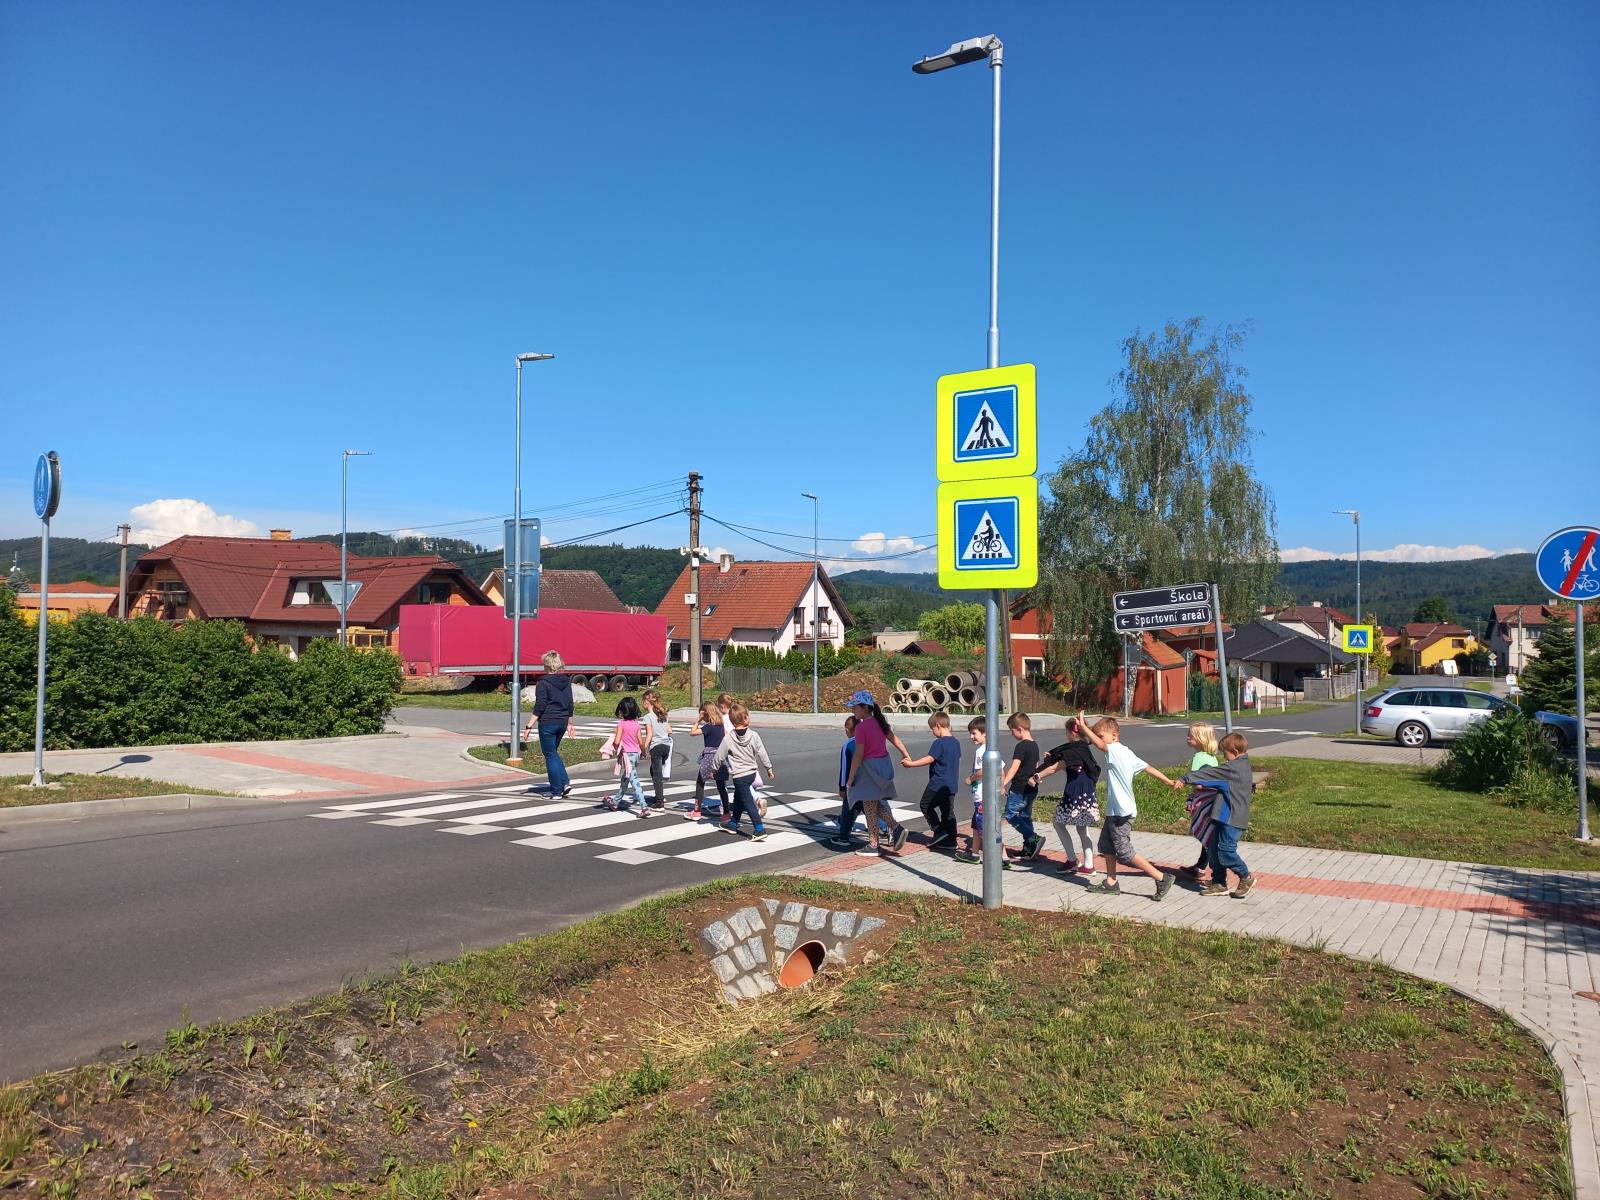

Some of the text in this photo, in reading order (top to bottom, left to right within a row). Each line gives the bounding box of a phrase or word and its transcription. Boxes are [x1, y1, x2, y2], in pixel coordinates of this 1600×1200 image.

[1170, 588, 1204, 603] Škola
[1134, 609, 1206, 627] Sportovní areál
